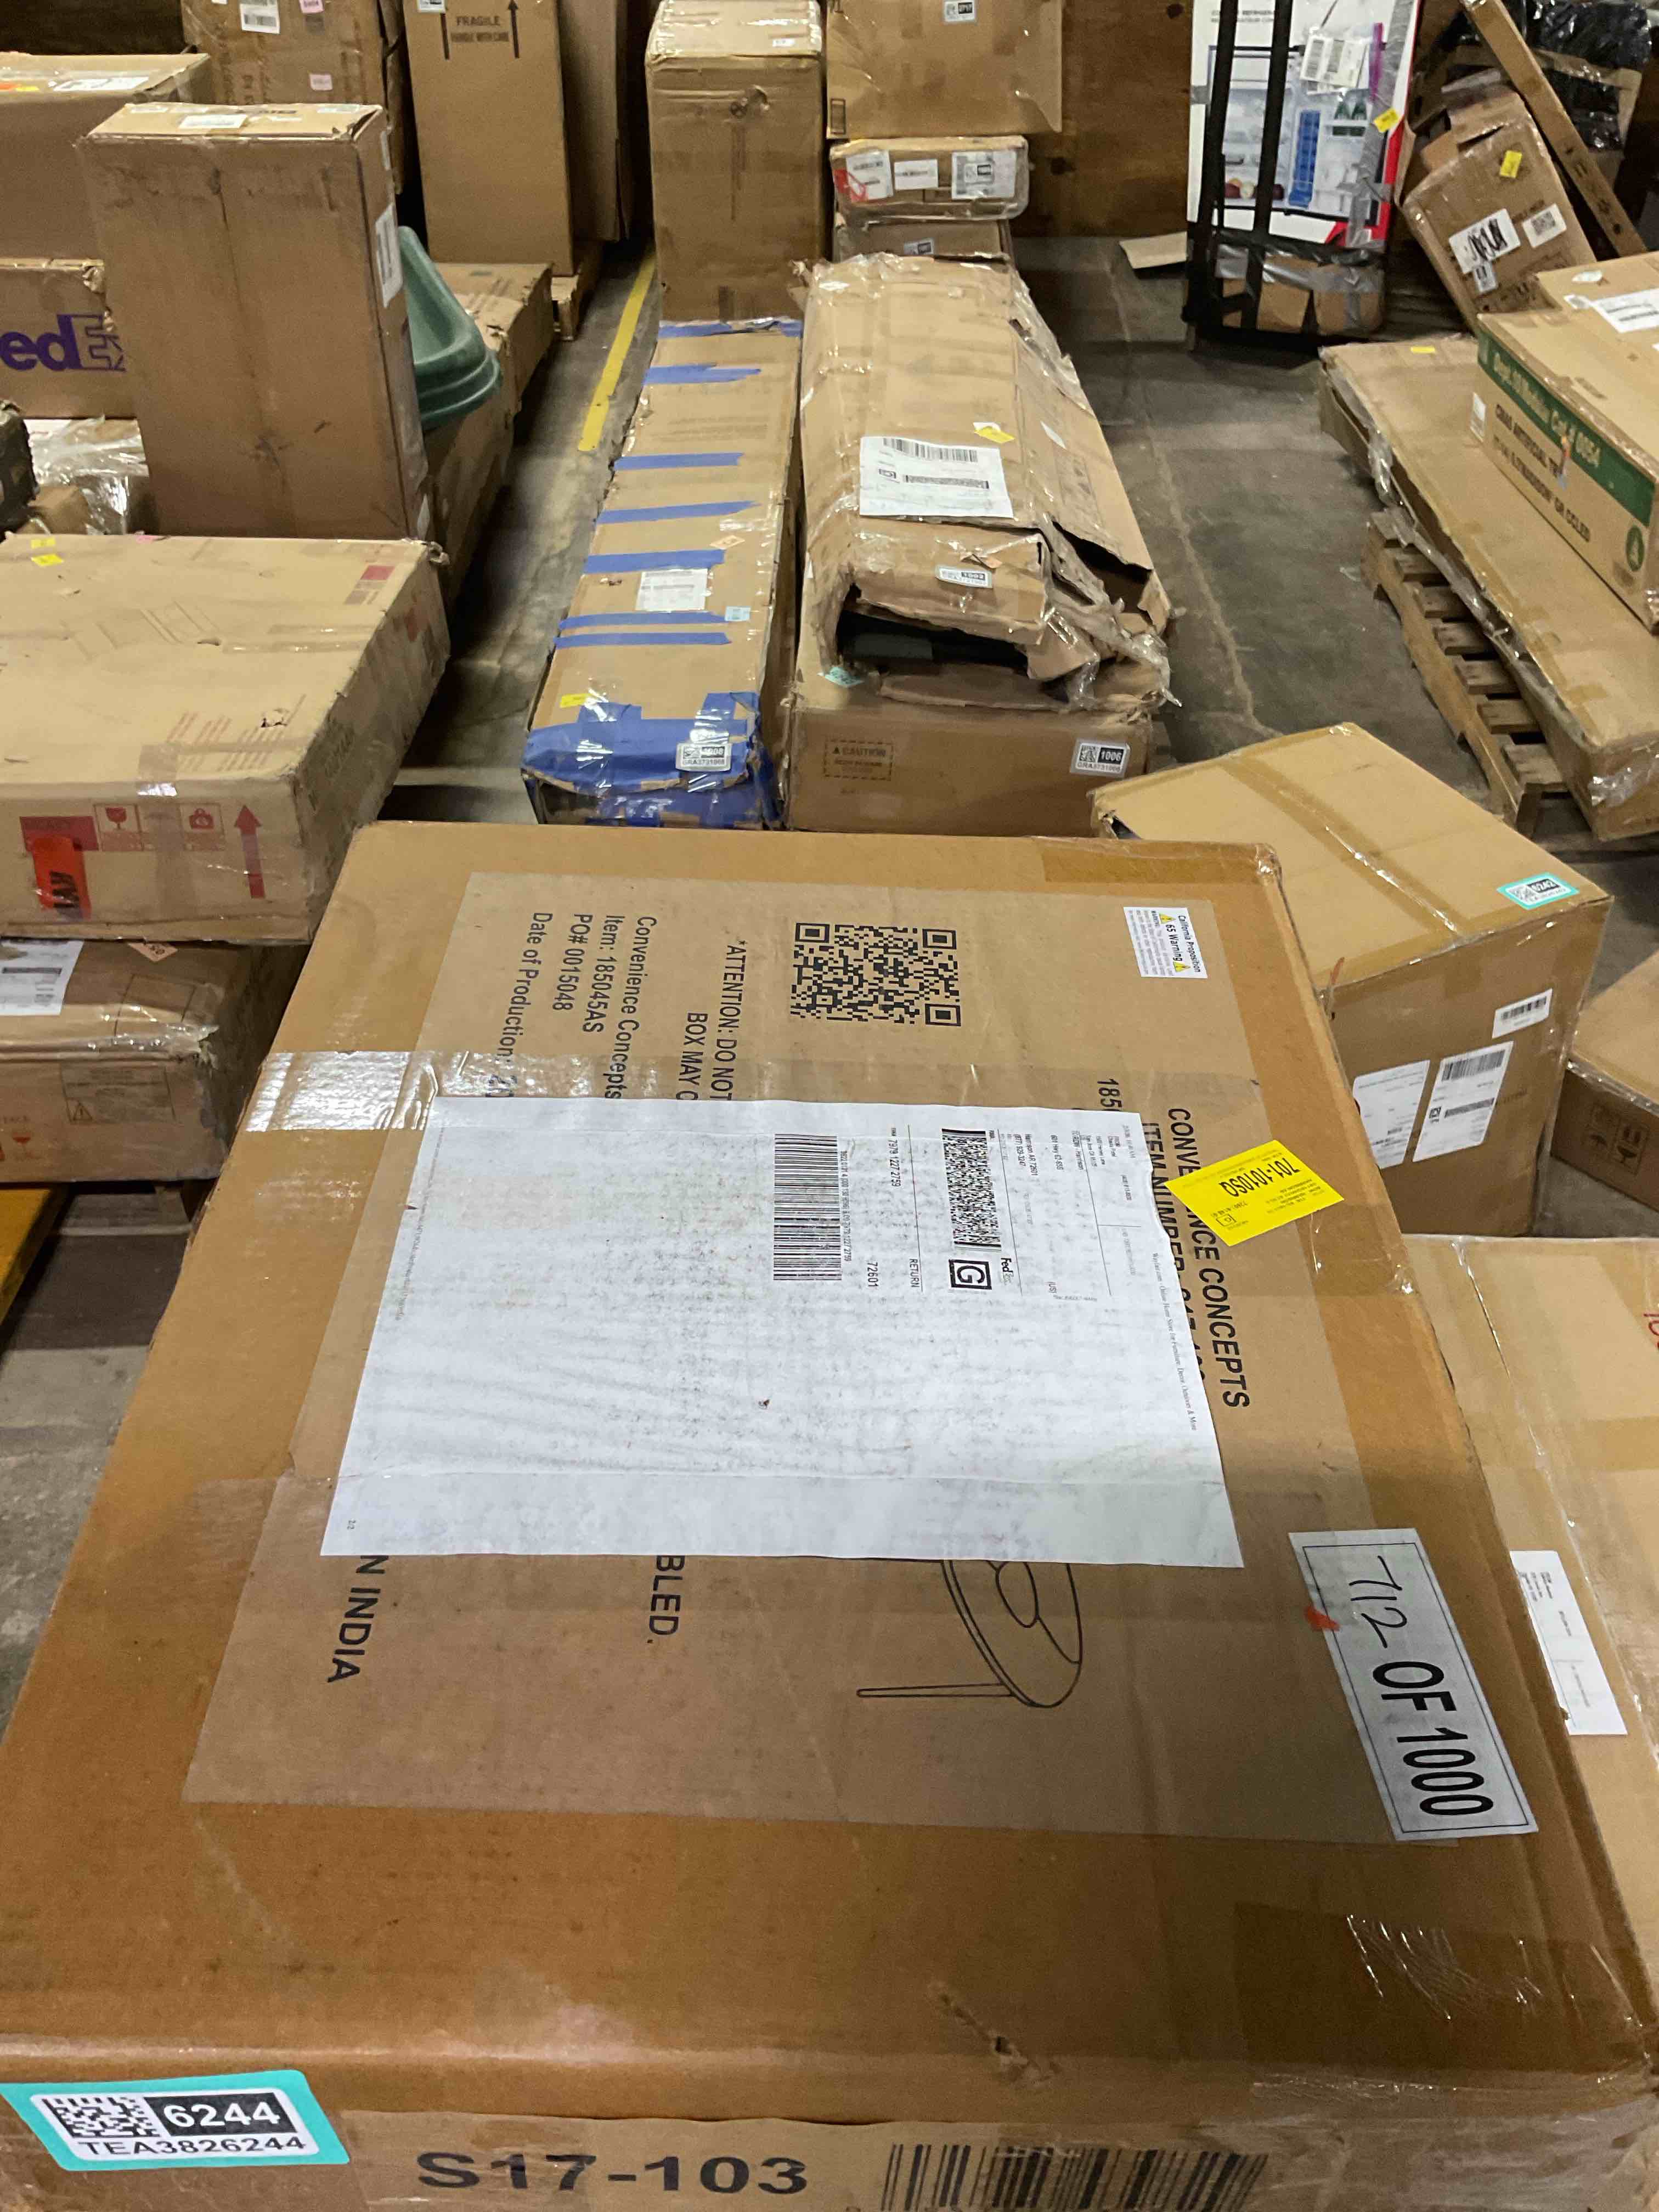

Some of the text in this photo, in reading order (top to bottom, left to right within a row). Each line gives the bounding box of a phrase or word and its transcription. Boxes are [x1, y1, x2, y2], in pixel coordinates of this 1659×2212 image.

[1101, 750, 1122, 762] 1006
[527, 912, 553, 944] Date
[522, 949, 541, 964] of
[1169, 934, 1183, 961] Warning
[1178, 915, 1201, 973] California Proposition
[552, 913, 593, 1011] PO# 0015048
[582, 915, 625, 1032] Item: 185045AS
[603, 916, 657, 1098] Convenience Concepts
[684, 1012, 708, 1045] BOX
[714, 1039, 738, 1062] DO
[678, 1051, 703, 1085] MAY
[710, 1068, 735, 1101] NOT
[1096, 1078, 1122, 1111] 185
[888, 1139, 898, 1154] 7979
[1025, 1134, 1033, 1153] Harrison
[1142, 1122, 1167, 1169] ITEM
[889, 1156, 900, 1171] 1227
[1219, 1158, 1300, 1197] 701-1010SQ
[891, 1172, 901, 1187] 2759
[867, 1262, 878, 1288] 72601
[909, 1259, 920, 1288] RETURN
[956, 1265, 986, 1284] G
[1163, 1303, 1171, 1317] Home
[1166, 1319, 1175, 1332] Store
[1199, 1268, 1250, 1408] CONCEPTS
[347, 1520, 356, 1530] 2/2
[327, 1587, 381, 1683] INDIA
[1348, 1555, 1494, 1816] 712 OF 1000
[163, 2101, 283, 2128] 6244
[78, 2136, 307, 2156] TEA3826244
[416, 2152, 808, 2195] S17-103
